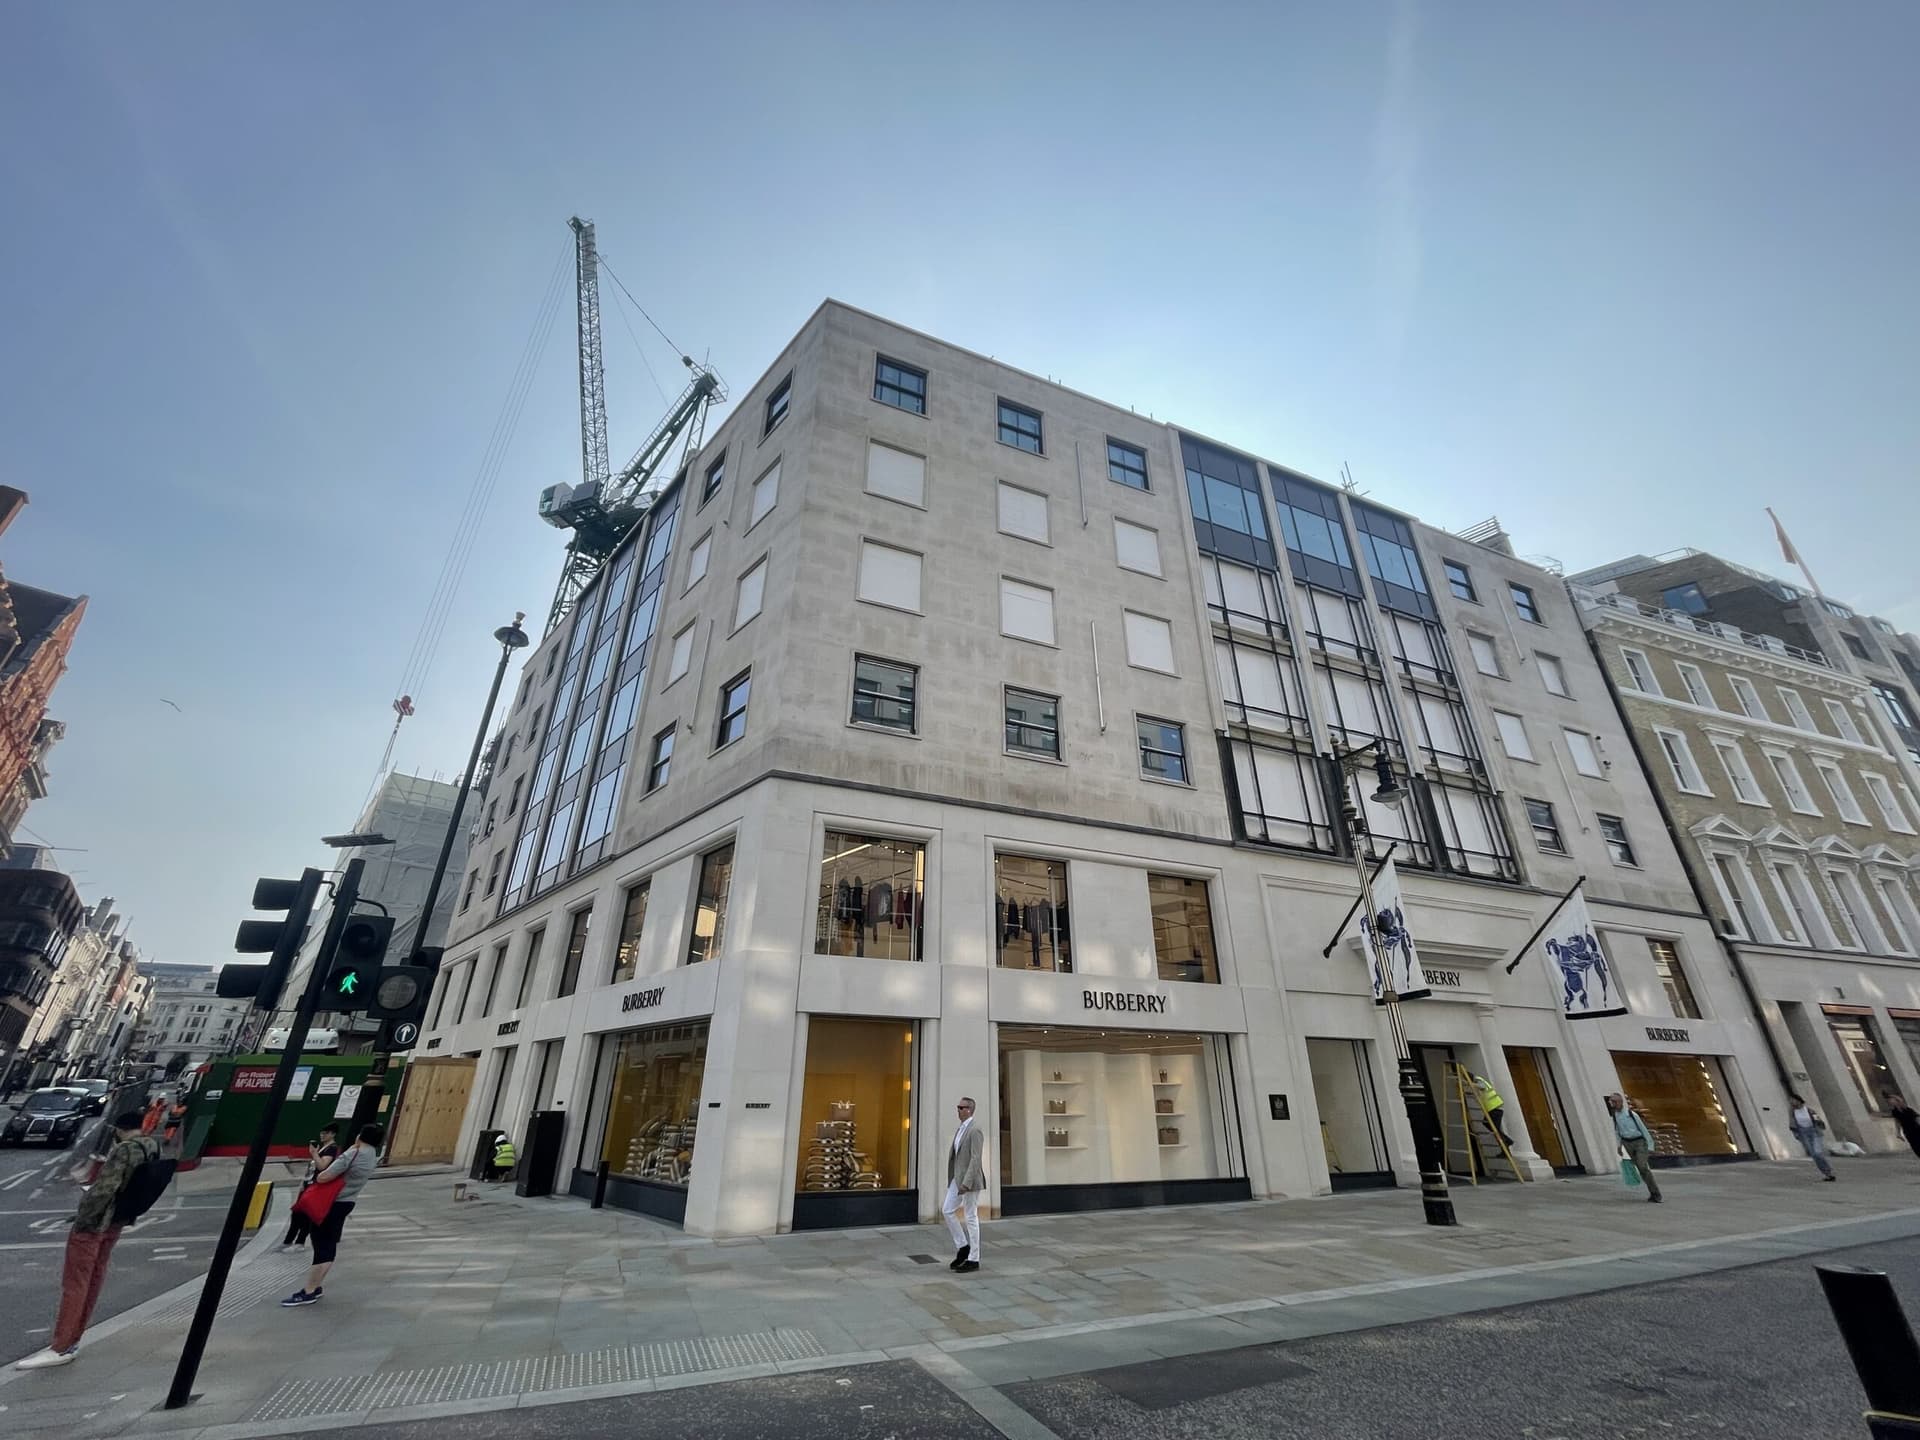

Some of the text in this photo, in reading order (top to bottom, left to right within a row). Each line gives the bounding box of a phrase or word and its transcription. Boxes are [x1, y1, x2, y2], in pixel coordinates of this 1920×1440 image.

[1422, 969, 1461, 987] BERRY
[622, 986, 665, 1012] BURBERRY
[1083, 990, 1167, 1013] BURBERRY
[1645, 1027, 1690, 1042] BURBERRY
